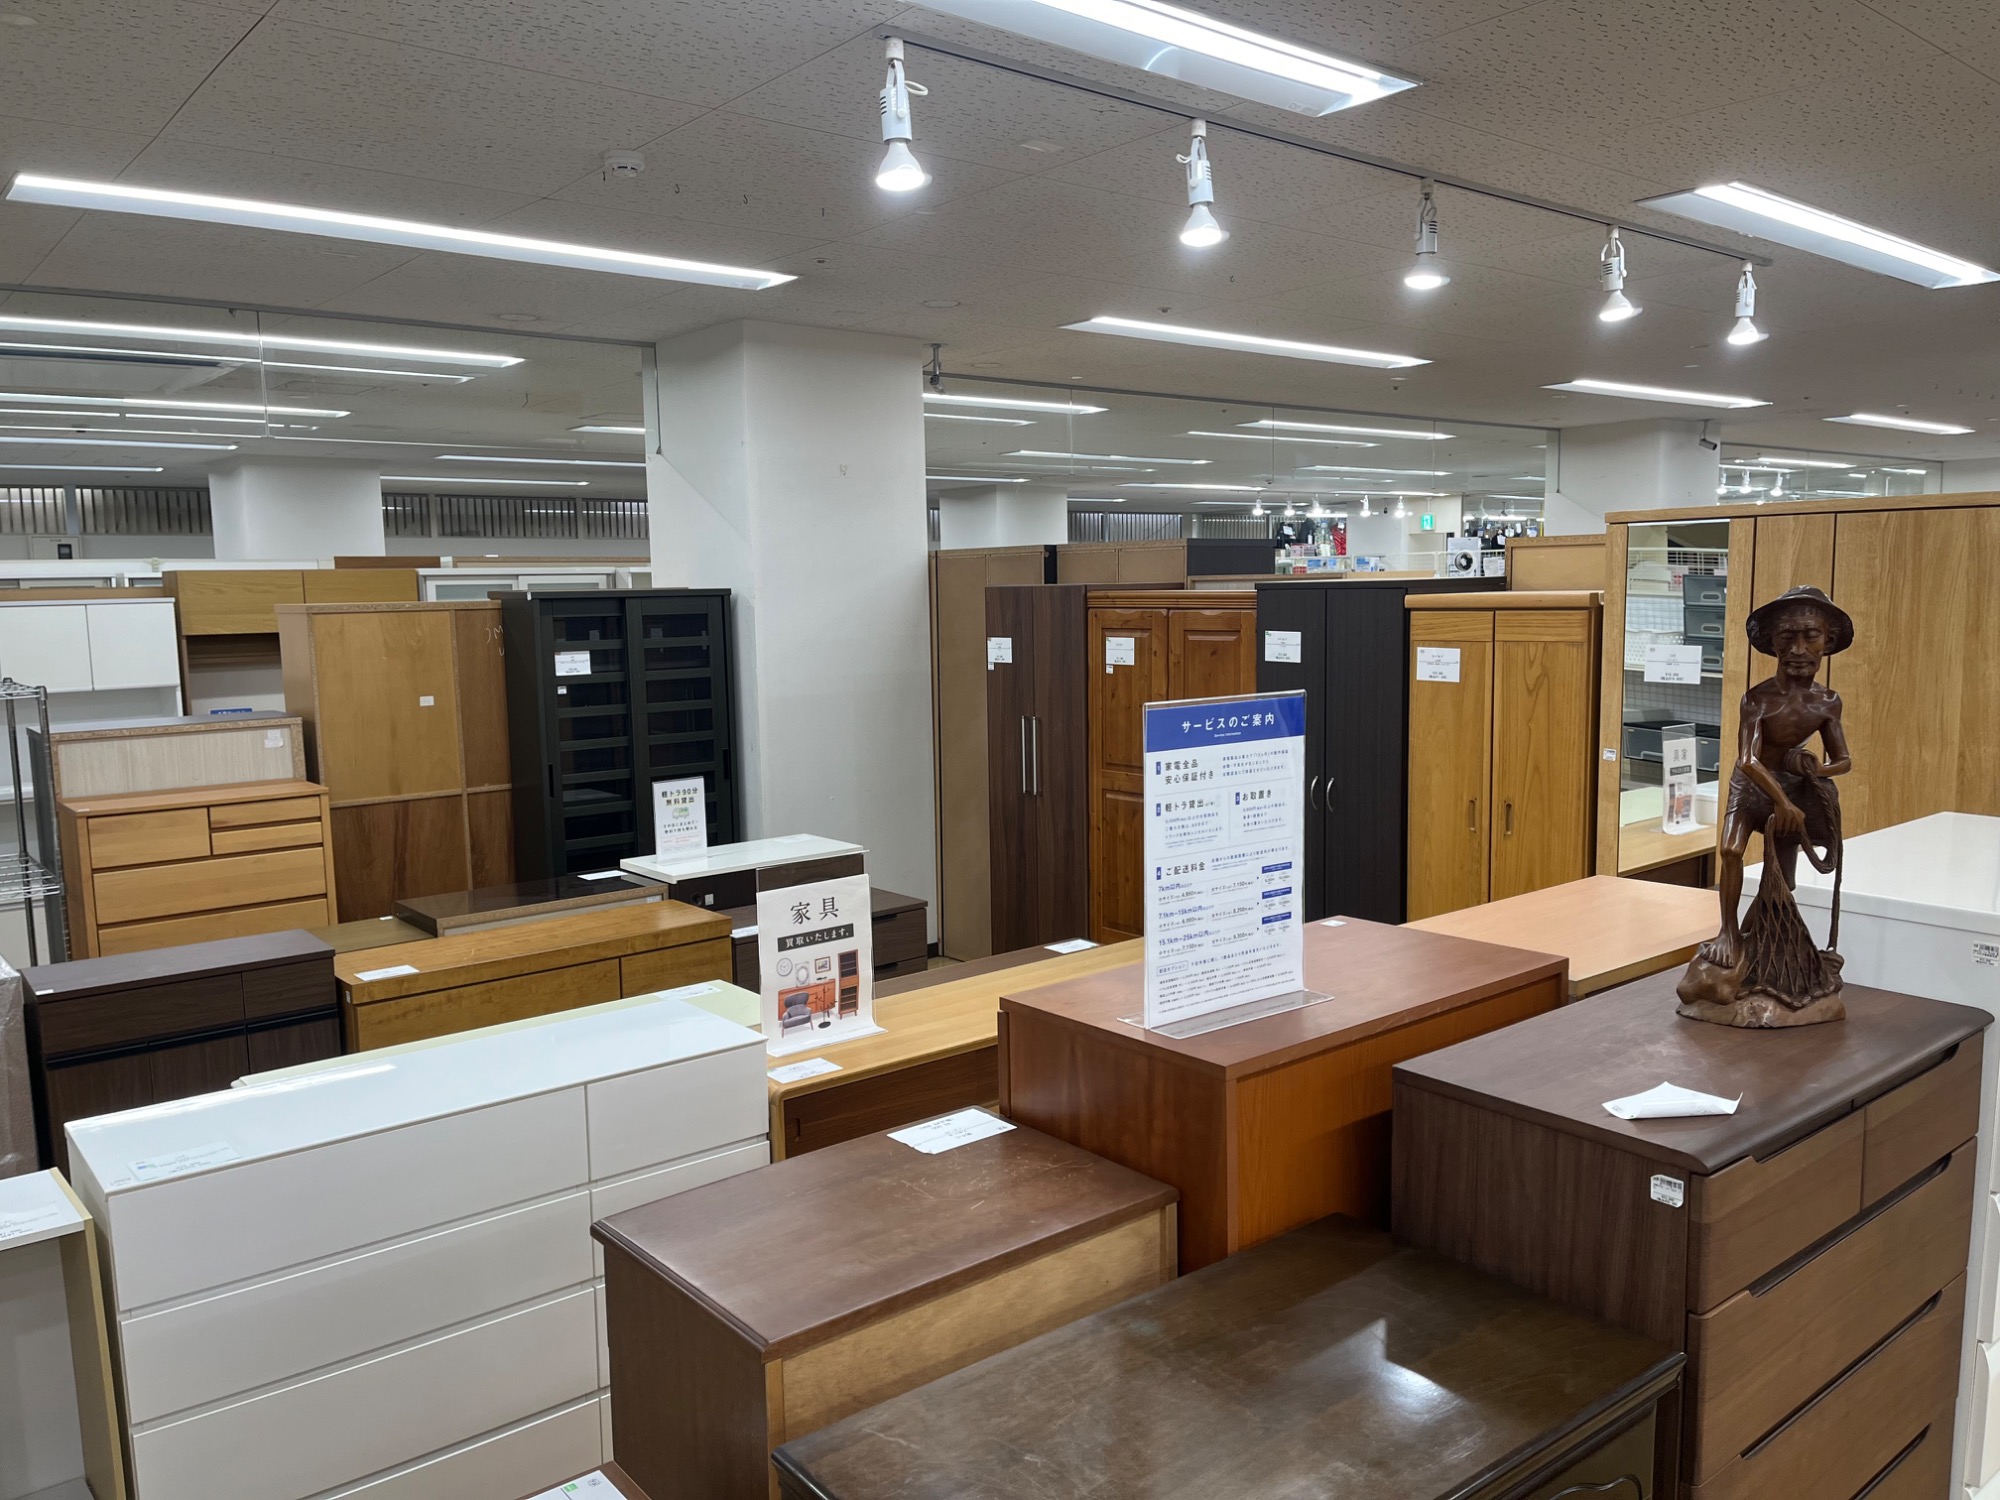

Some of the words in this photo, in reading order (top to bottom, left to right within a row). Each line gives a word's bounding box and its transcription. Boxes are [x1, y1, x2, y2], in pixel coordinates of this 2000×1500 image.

[1181, 712, 1275, 733] サービスのご案内
[1165, 759, 1198, 771] 家電全品
[1165, 770, 1213, 785] 安心保証付き
[661, 787, 698, 798] 軽トラ90分
[1242, 789, 1271, 801] お取置き
[666, 797, 695, 806] 無料貸出
[1165, 799, 1203, 812] 軽トラ貸出
[1166, 861, 1205, 876] ご配送料金
[790, 896, 839, 925] 家具
[785, 927, 849, 949] 買取いたします。
